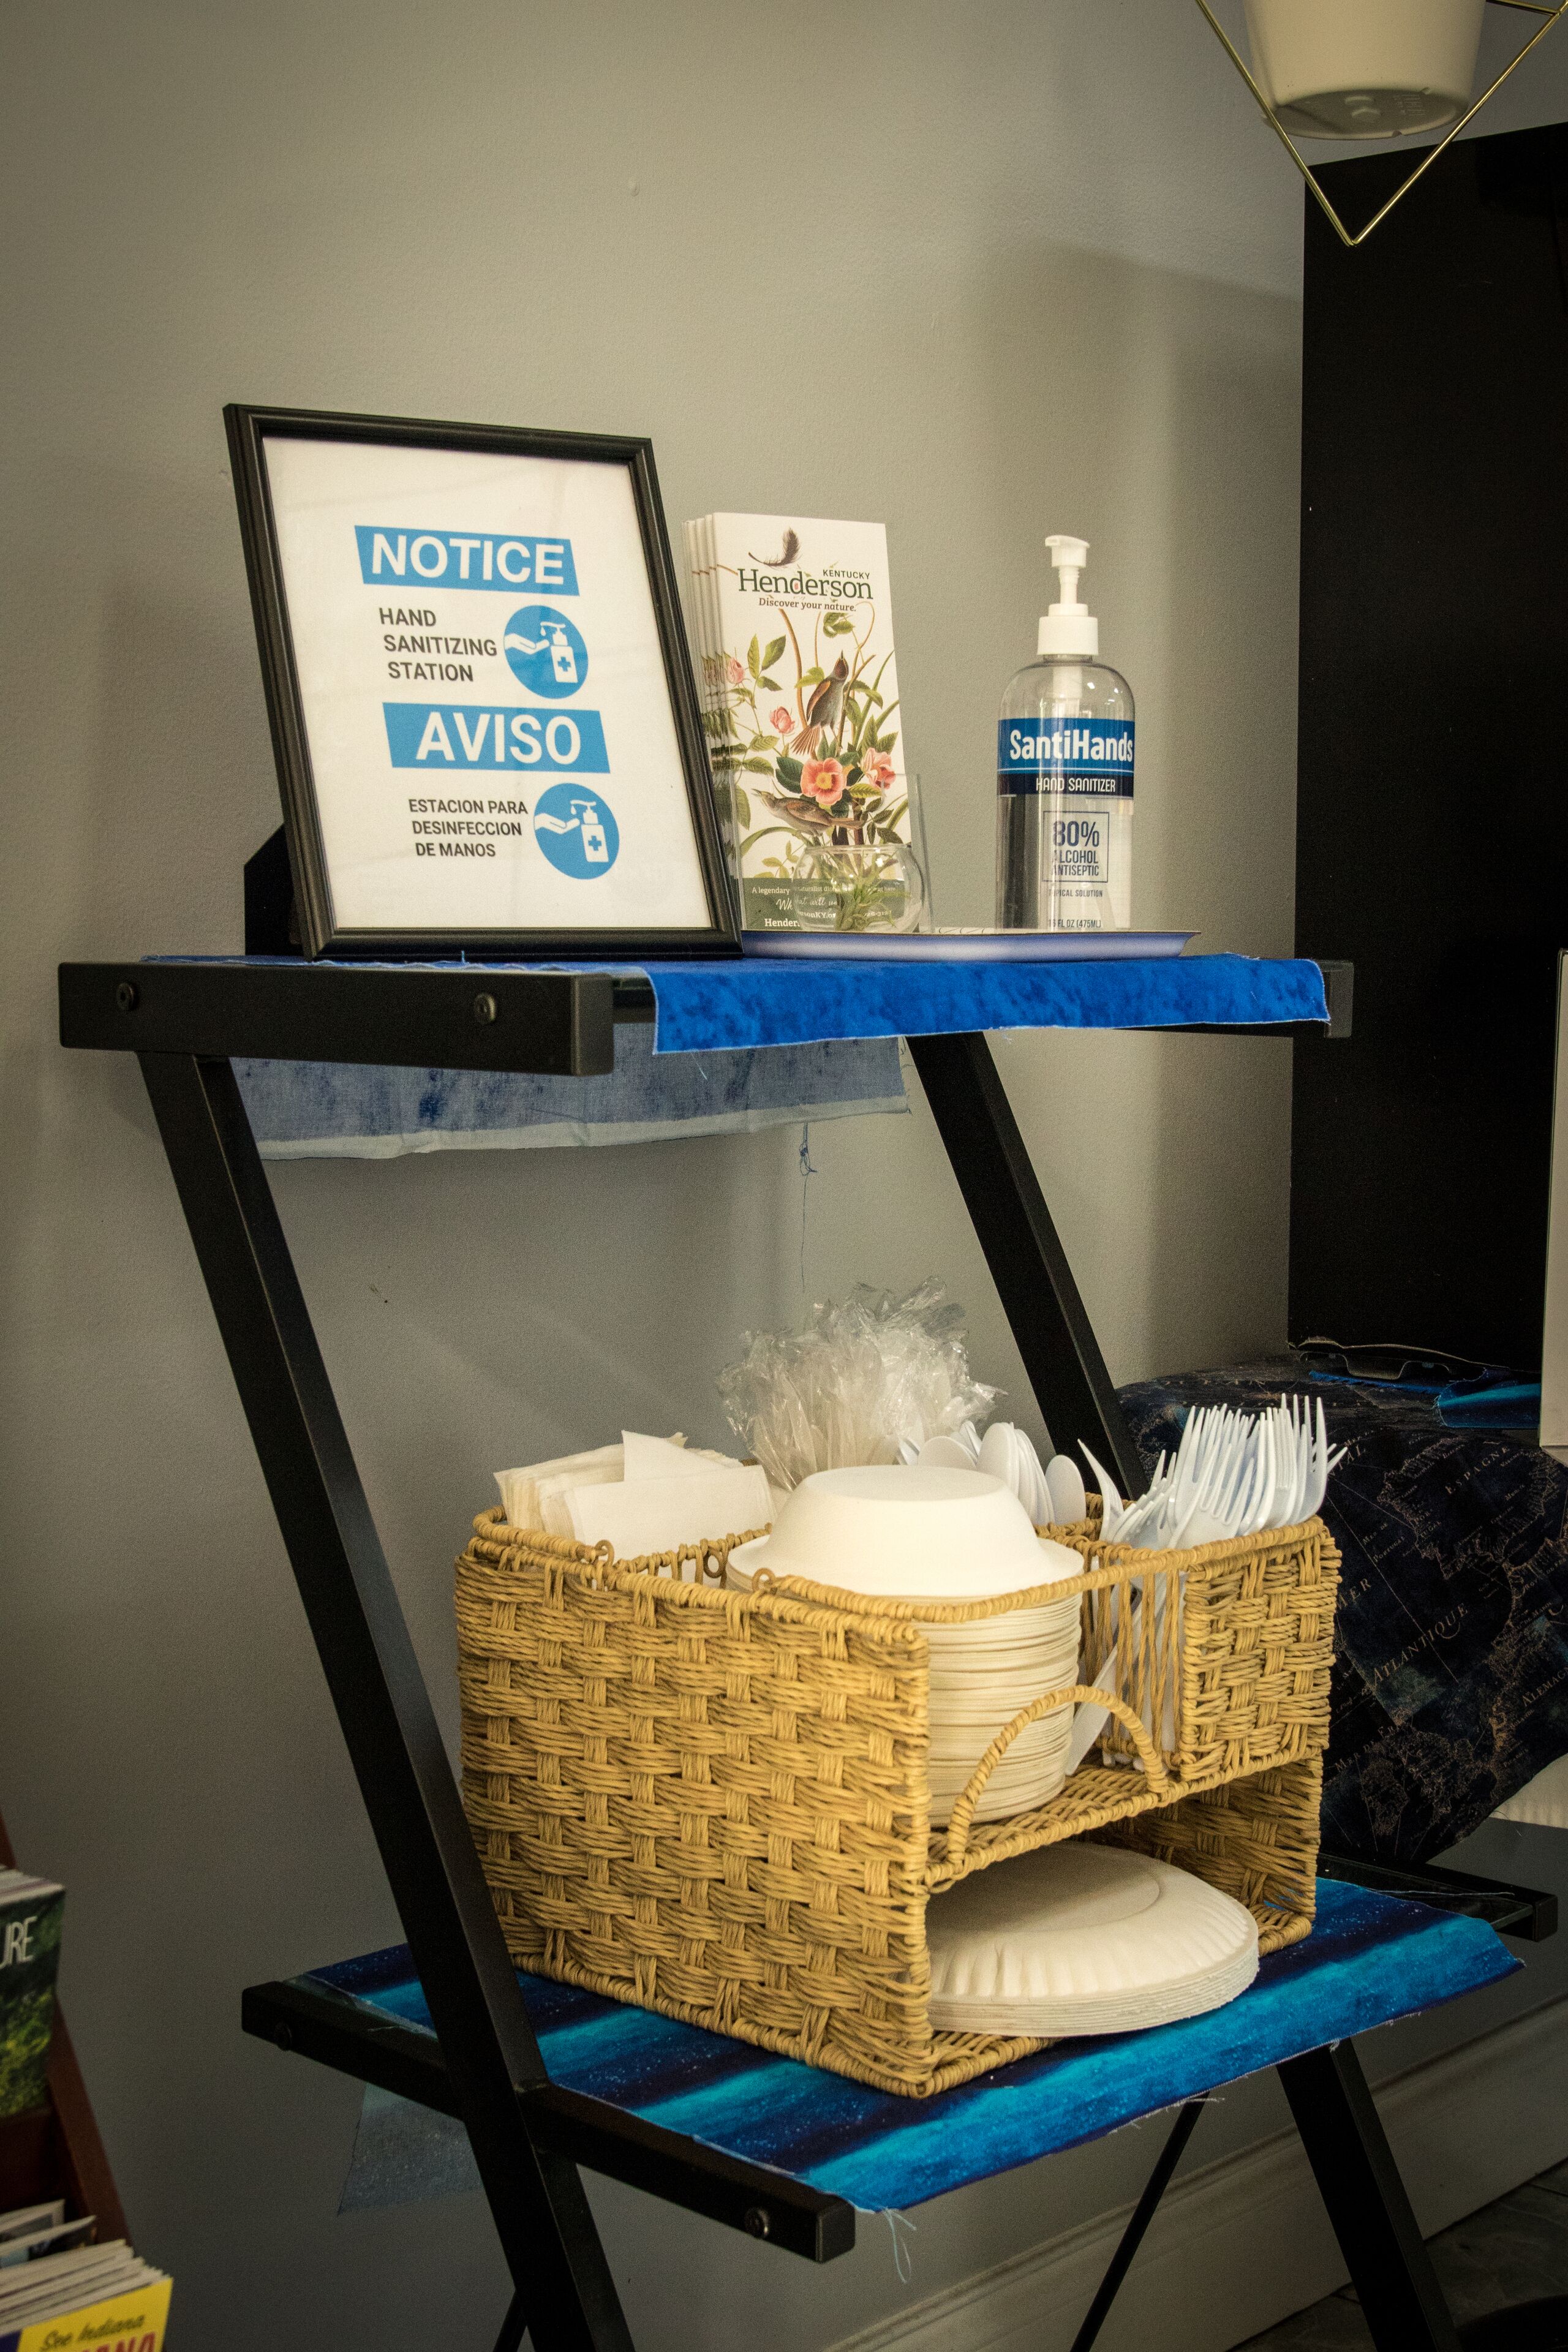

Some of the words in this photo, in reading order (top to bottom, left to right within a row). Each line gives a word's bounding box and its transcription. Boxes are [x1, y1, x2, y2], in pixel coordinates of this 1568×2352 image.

[371, 532, 565, 585] NOTICE
[737, 568, 873, 600] Henderson
[823, 569, 870, 580] KENTUCKY
[758, 597, 799, 608] Discover
[801, 601, 822, 611] your
[824, 602, 856, 612] nature.
[379, 606, 437, 628] HAND
[383, 633, 497, 657] SANITIZING
[387, 661, 474, 682] STATION
[415, 710, 581, 765] AVISO
[1009, 728, 1133, 763] SantiHands
[1036, 777, 1065, 791] HAND
[1068, 777, 1116, 793] SANITIZER
[409, 798, 484, 815] ESTACION
[488, 800, 529, 815] PARA
[412, 820, 522, 837] DESINFECCION
[1052, 820, 1100, 848] 80%
[415, 842, 436, 857] DE
[439, 843, 496, 858] MANOS
[758, 886, 790, 895] legendary
[1066, 919, 1074, 928] OZ
[1372, 1603, 1469, 1688] ATLANTIQUE
[1522, 1665, 1568, 1707] ALEMAG
